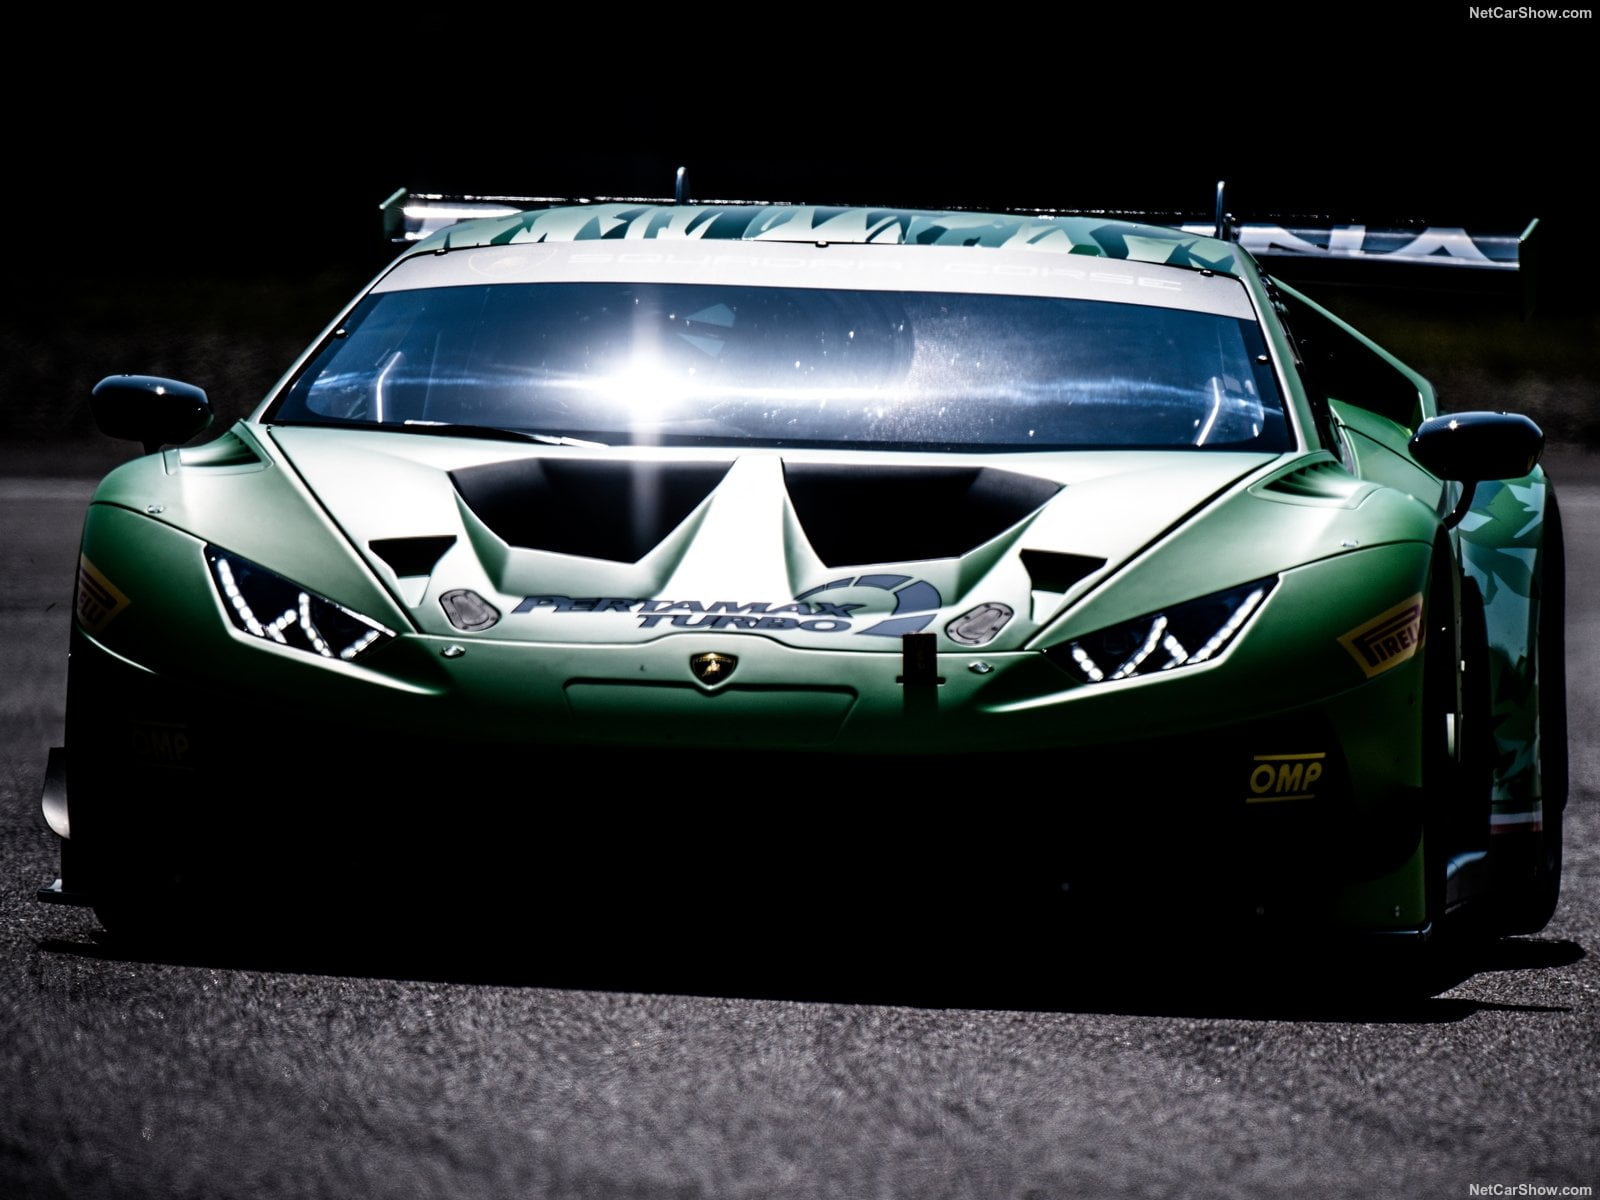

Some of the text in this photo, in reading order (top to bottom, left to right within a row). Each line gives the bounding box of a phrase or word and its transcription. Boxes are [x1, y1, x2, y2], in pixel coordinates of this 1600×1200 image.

[944, 262, 1184, 291] CORSE
[511, 595, 866, 618] PERTAMAX
[637, 614, 851, 632] TURBO
[1249, 761, 1322, 794] OMP
